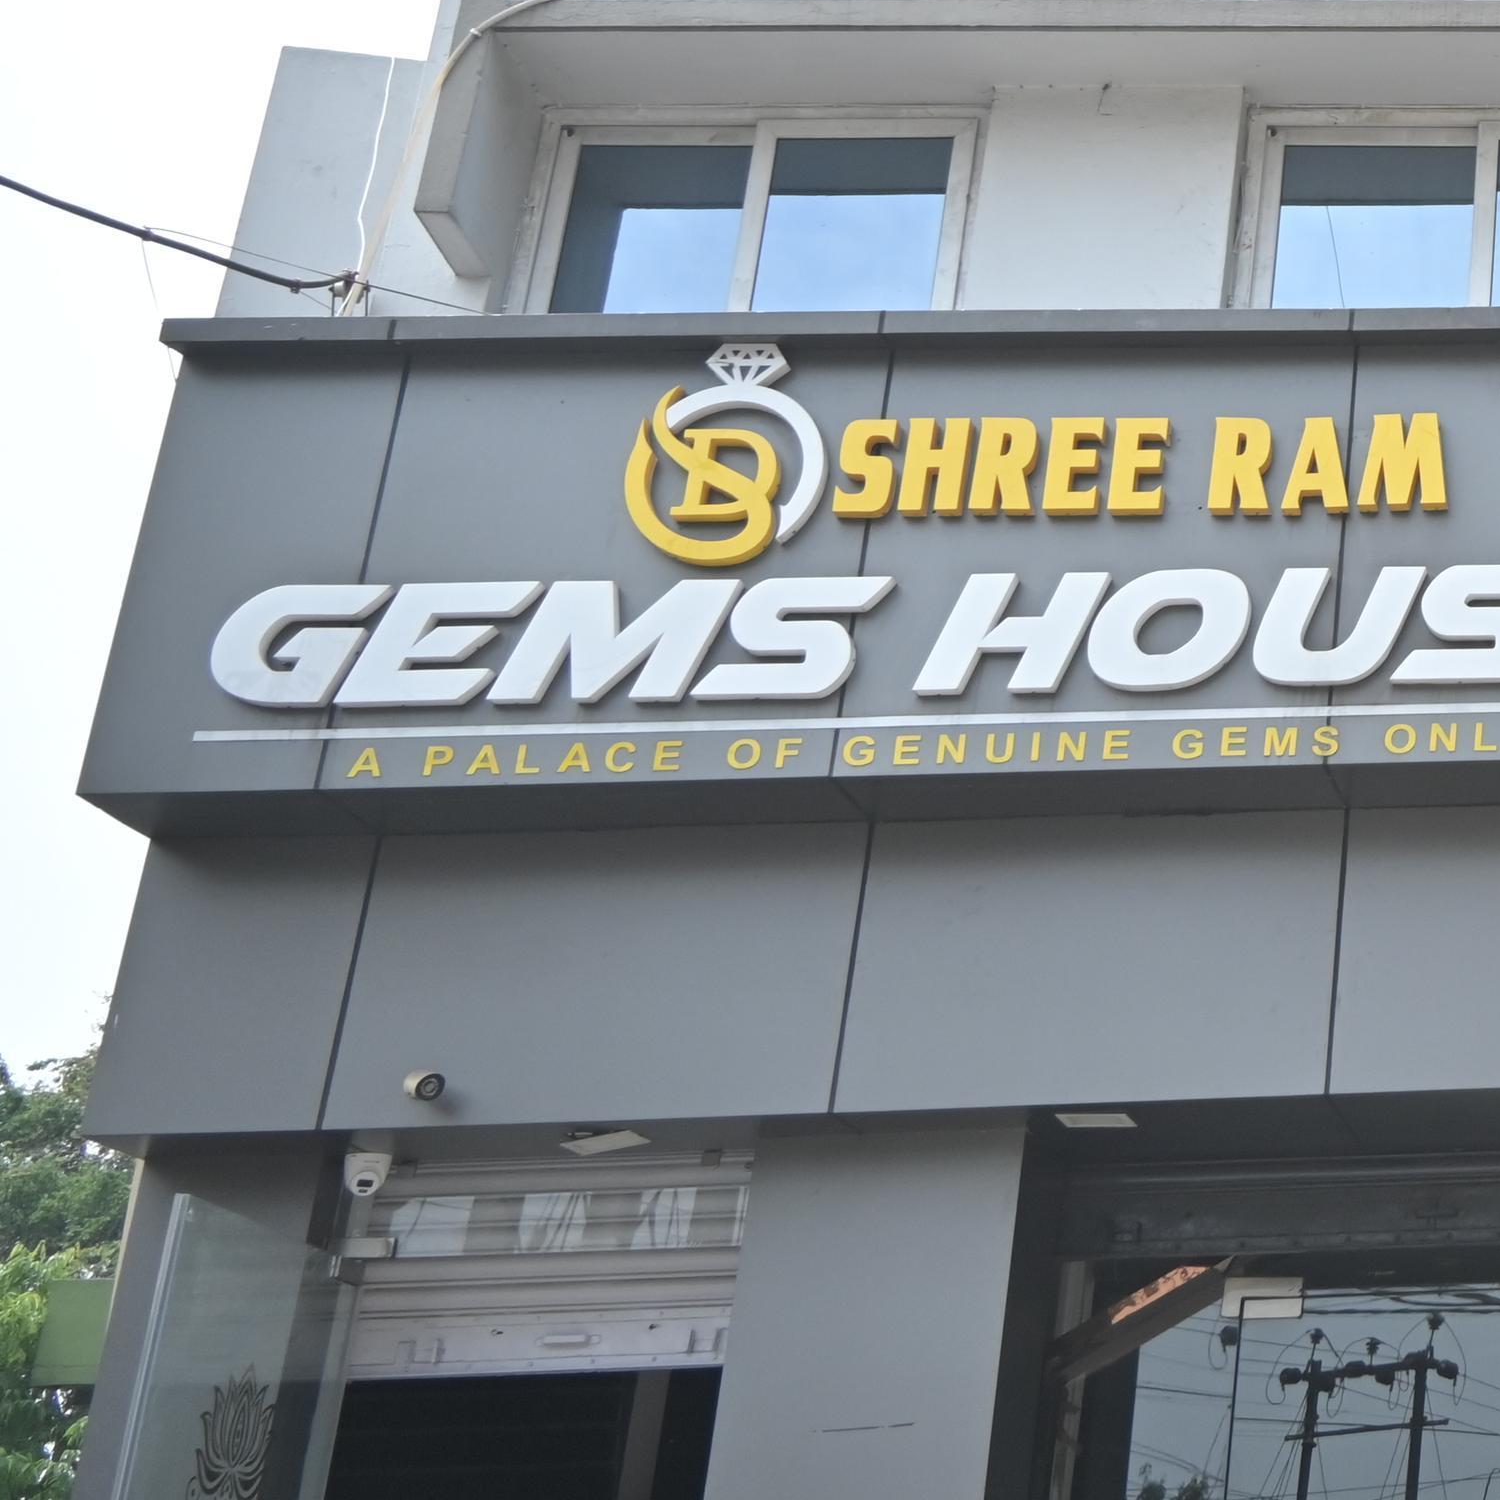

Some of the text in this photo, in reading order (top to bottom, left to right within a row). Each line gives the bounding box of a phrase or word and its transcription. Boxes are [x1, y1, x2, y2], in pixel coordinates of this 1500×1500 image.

[832, 411, 1450, 519] SHREE RAM
[210, 575, 898, 709] GEMS
[346, 747, 382, 779] A
[422, 740, 685, 777] PALACE
[725, 737, 805, 770] OF
[842, 728, 1132, 767] GENUINE
[1171, 725, 1341, 760] GEMS
